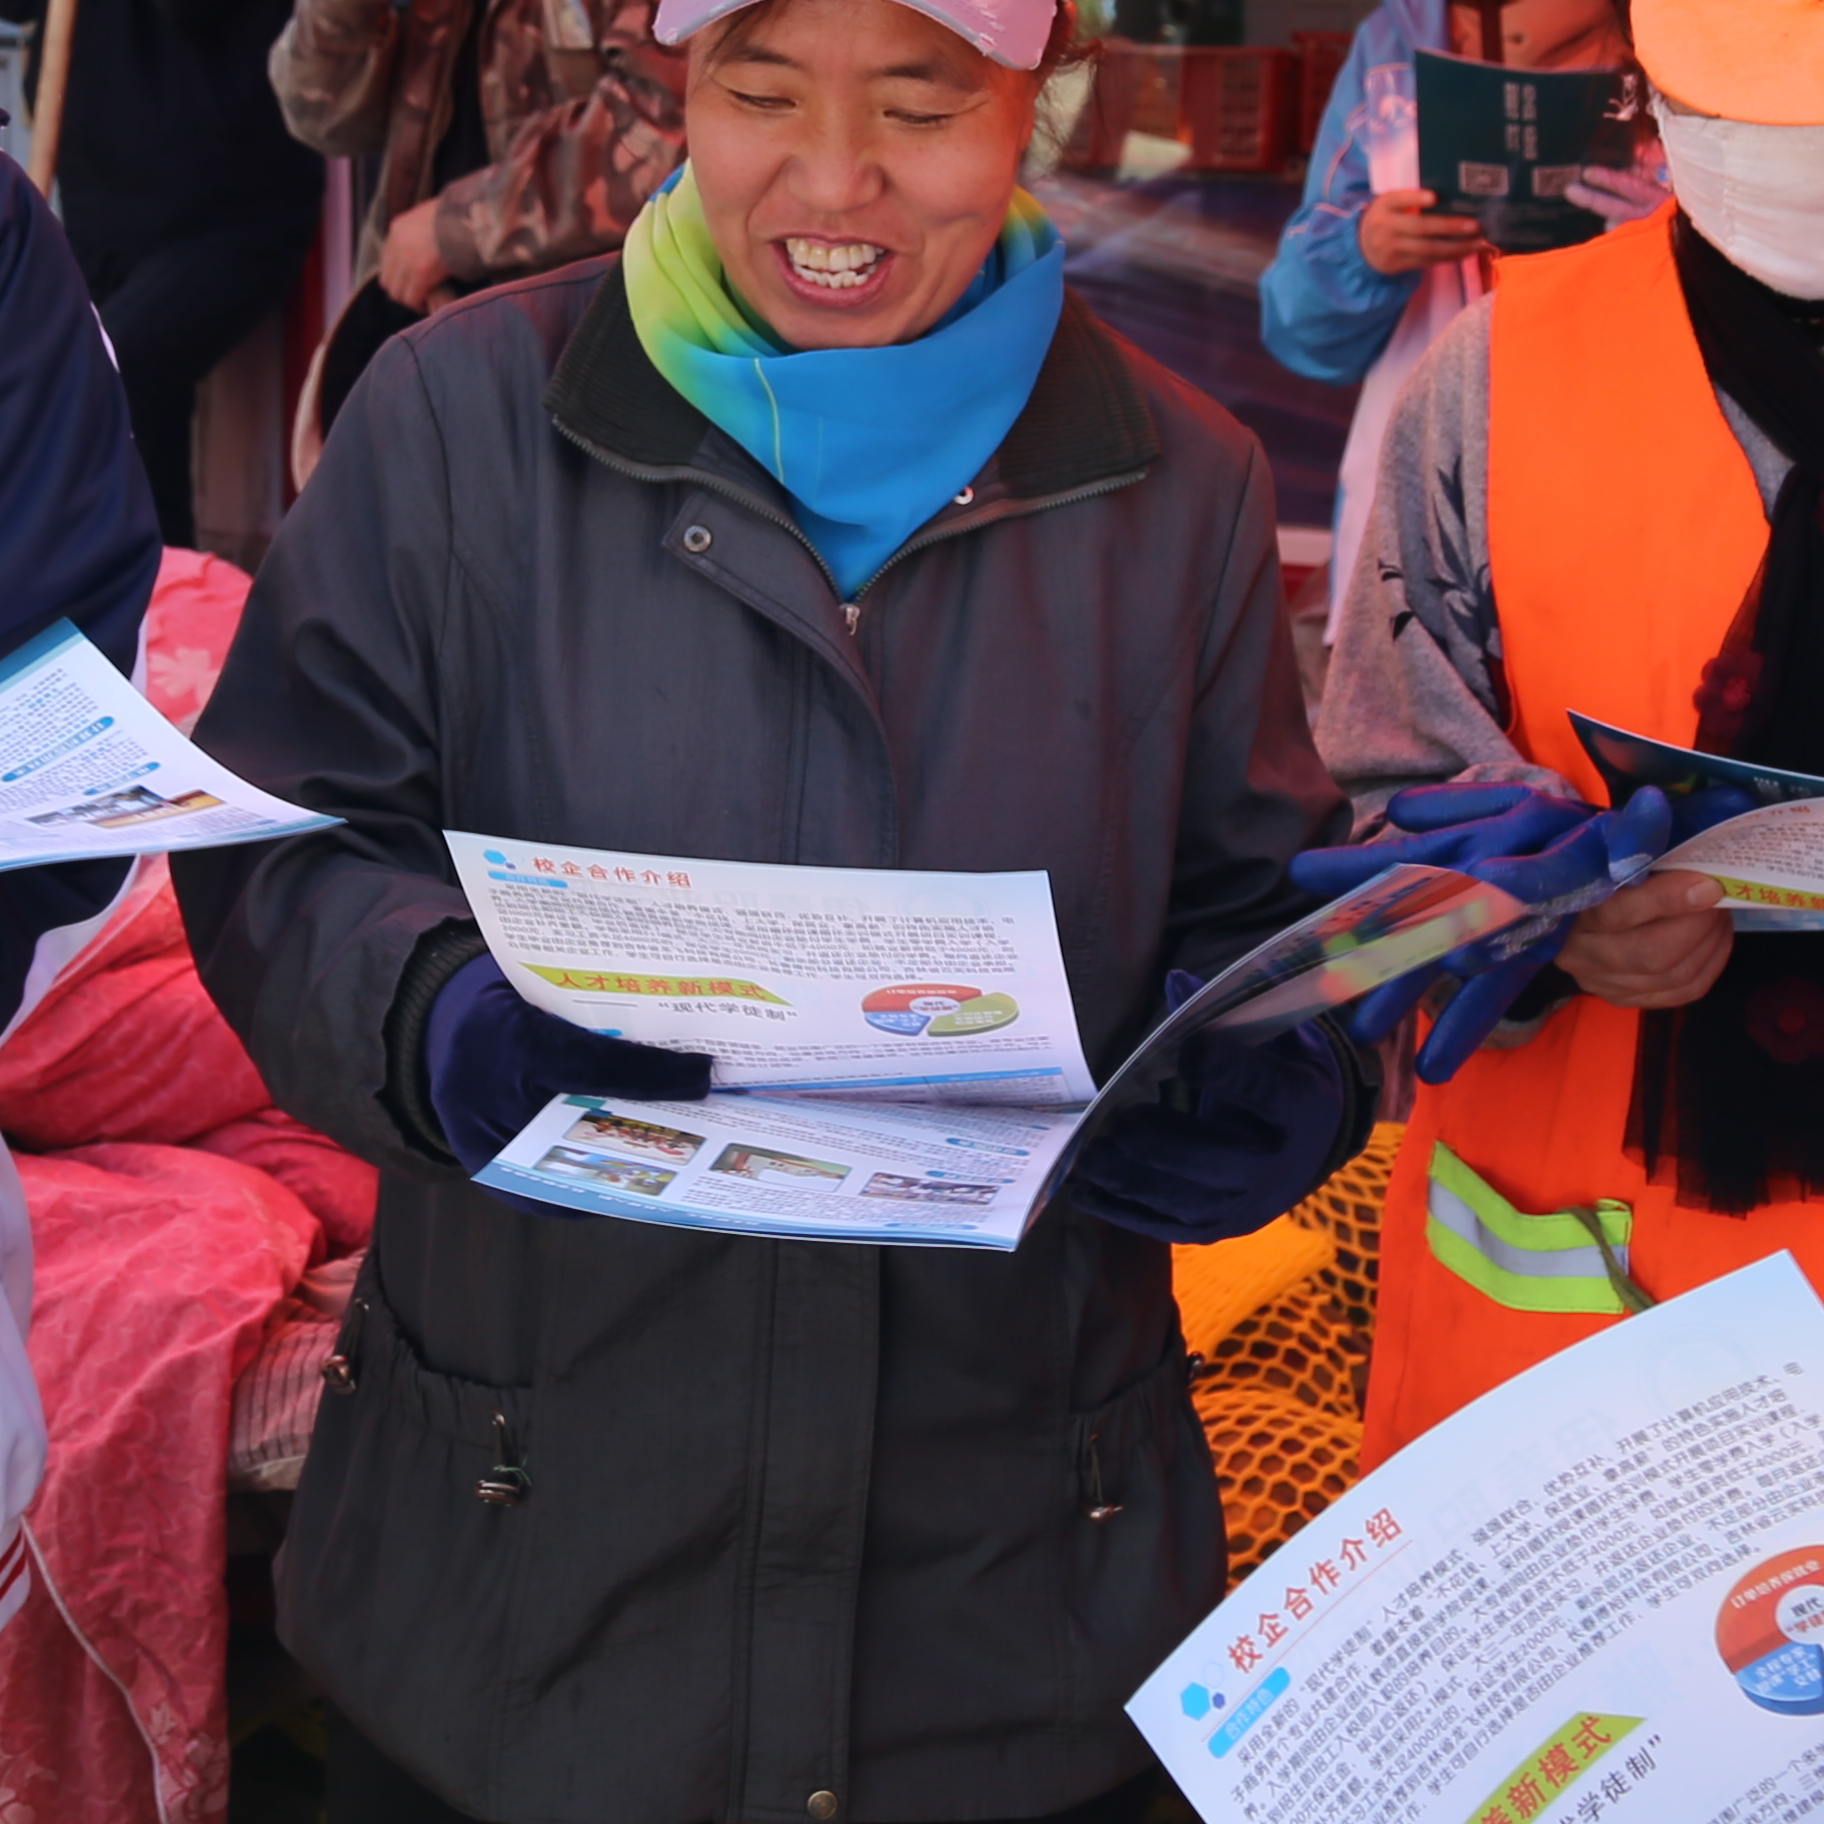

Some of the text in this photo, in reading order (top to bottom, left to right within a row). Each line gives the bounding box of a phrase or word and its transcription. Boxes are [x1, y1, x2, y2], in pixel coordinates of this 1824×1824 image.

[532, 856, 693, 889] 校企合作介绍
[557, 971, 767, 1001] 人才培养新模式
[1227, 1508, 1403, 1674] 校企合作介绍
